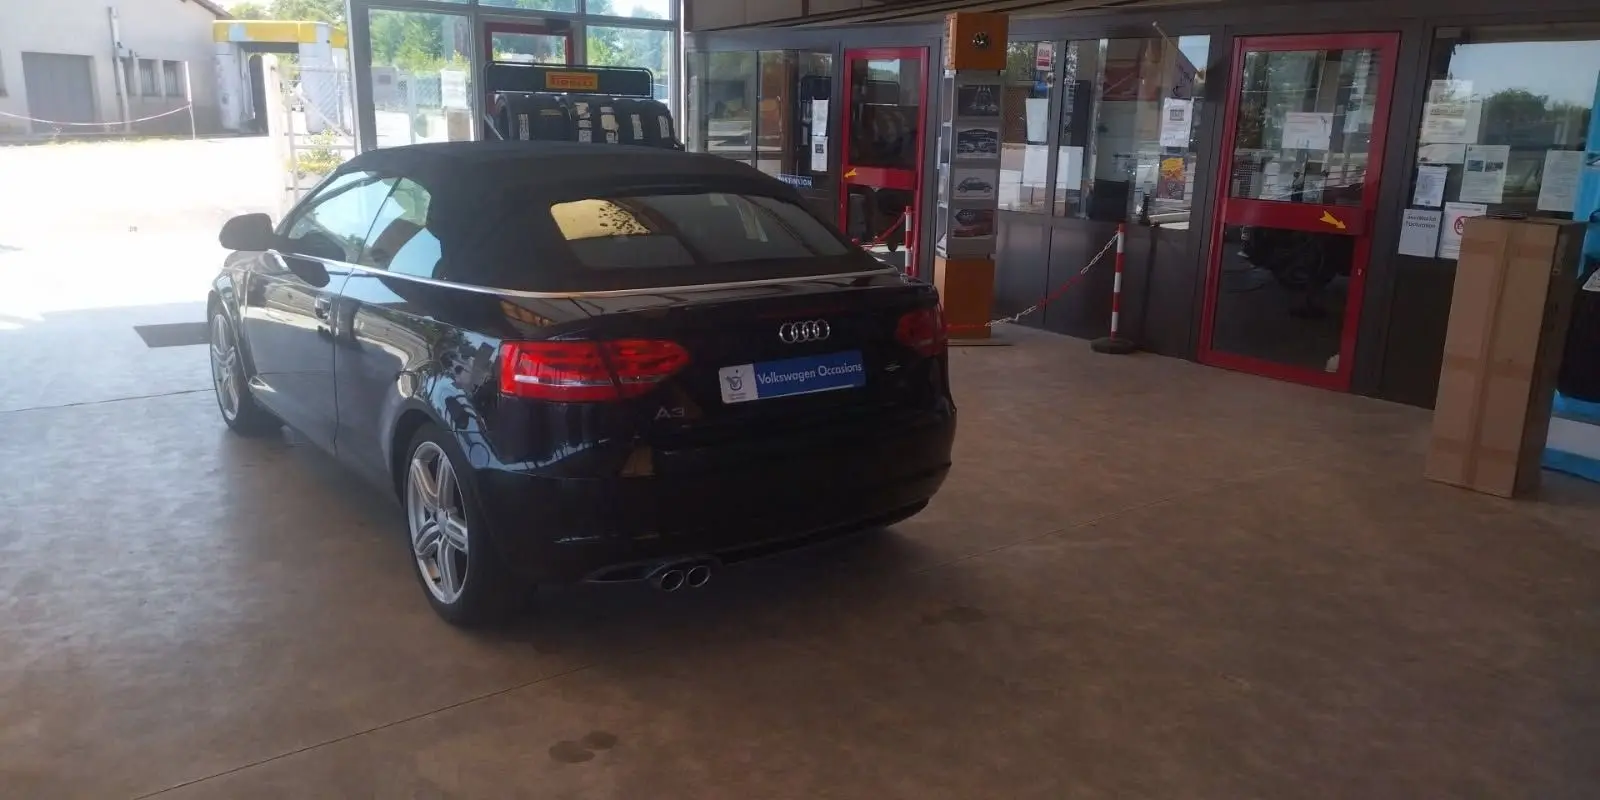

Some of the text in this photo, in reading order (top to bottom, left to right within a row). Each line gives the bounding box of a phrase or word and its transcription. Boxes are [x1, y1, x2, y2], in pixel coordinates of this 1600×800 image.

[757, 362, 862, 384] Volkswagen Occasions
[654, 406, 685, 420] A3
